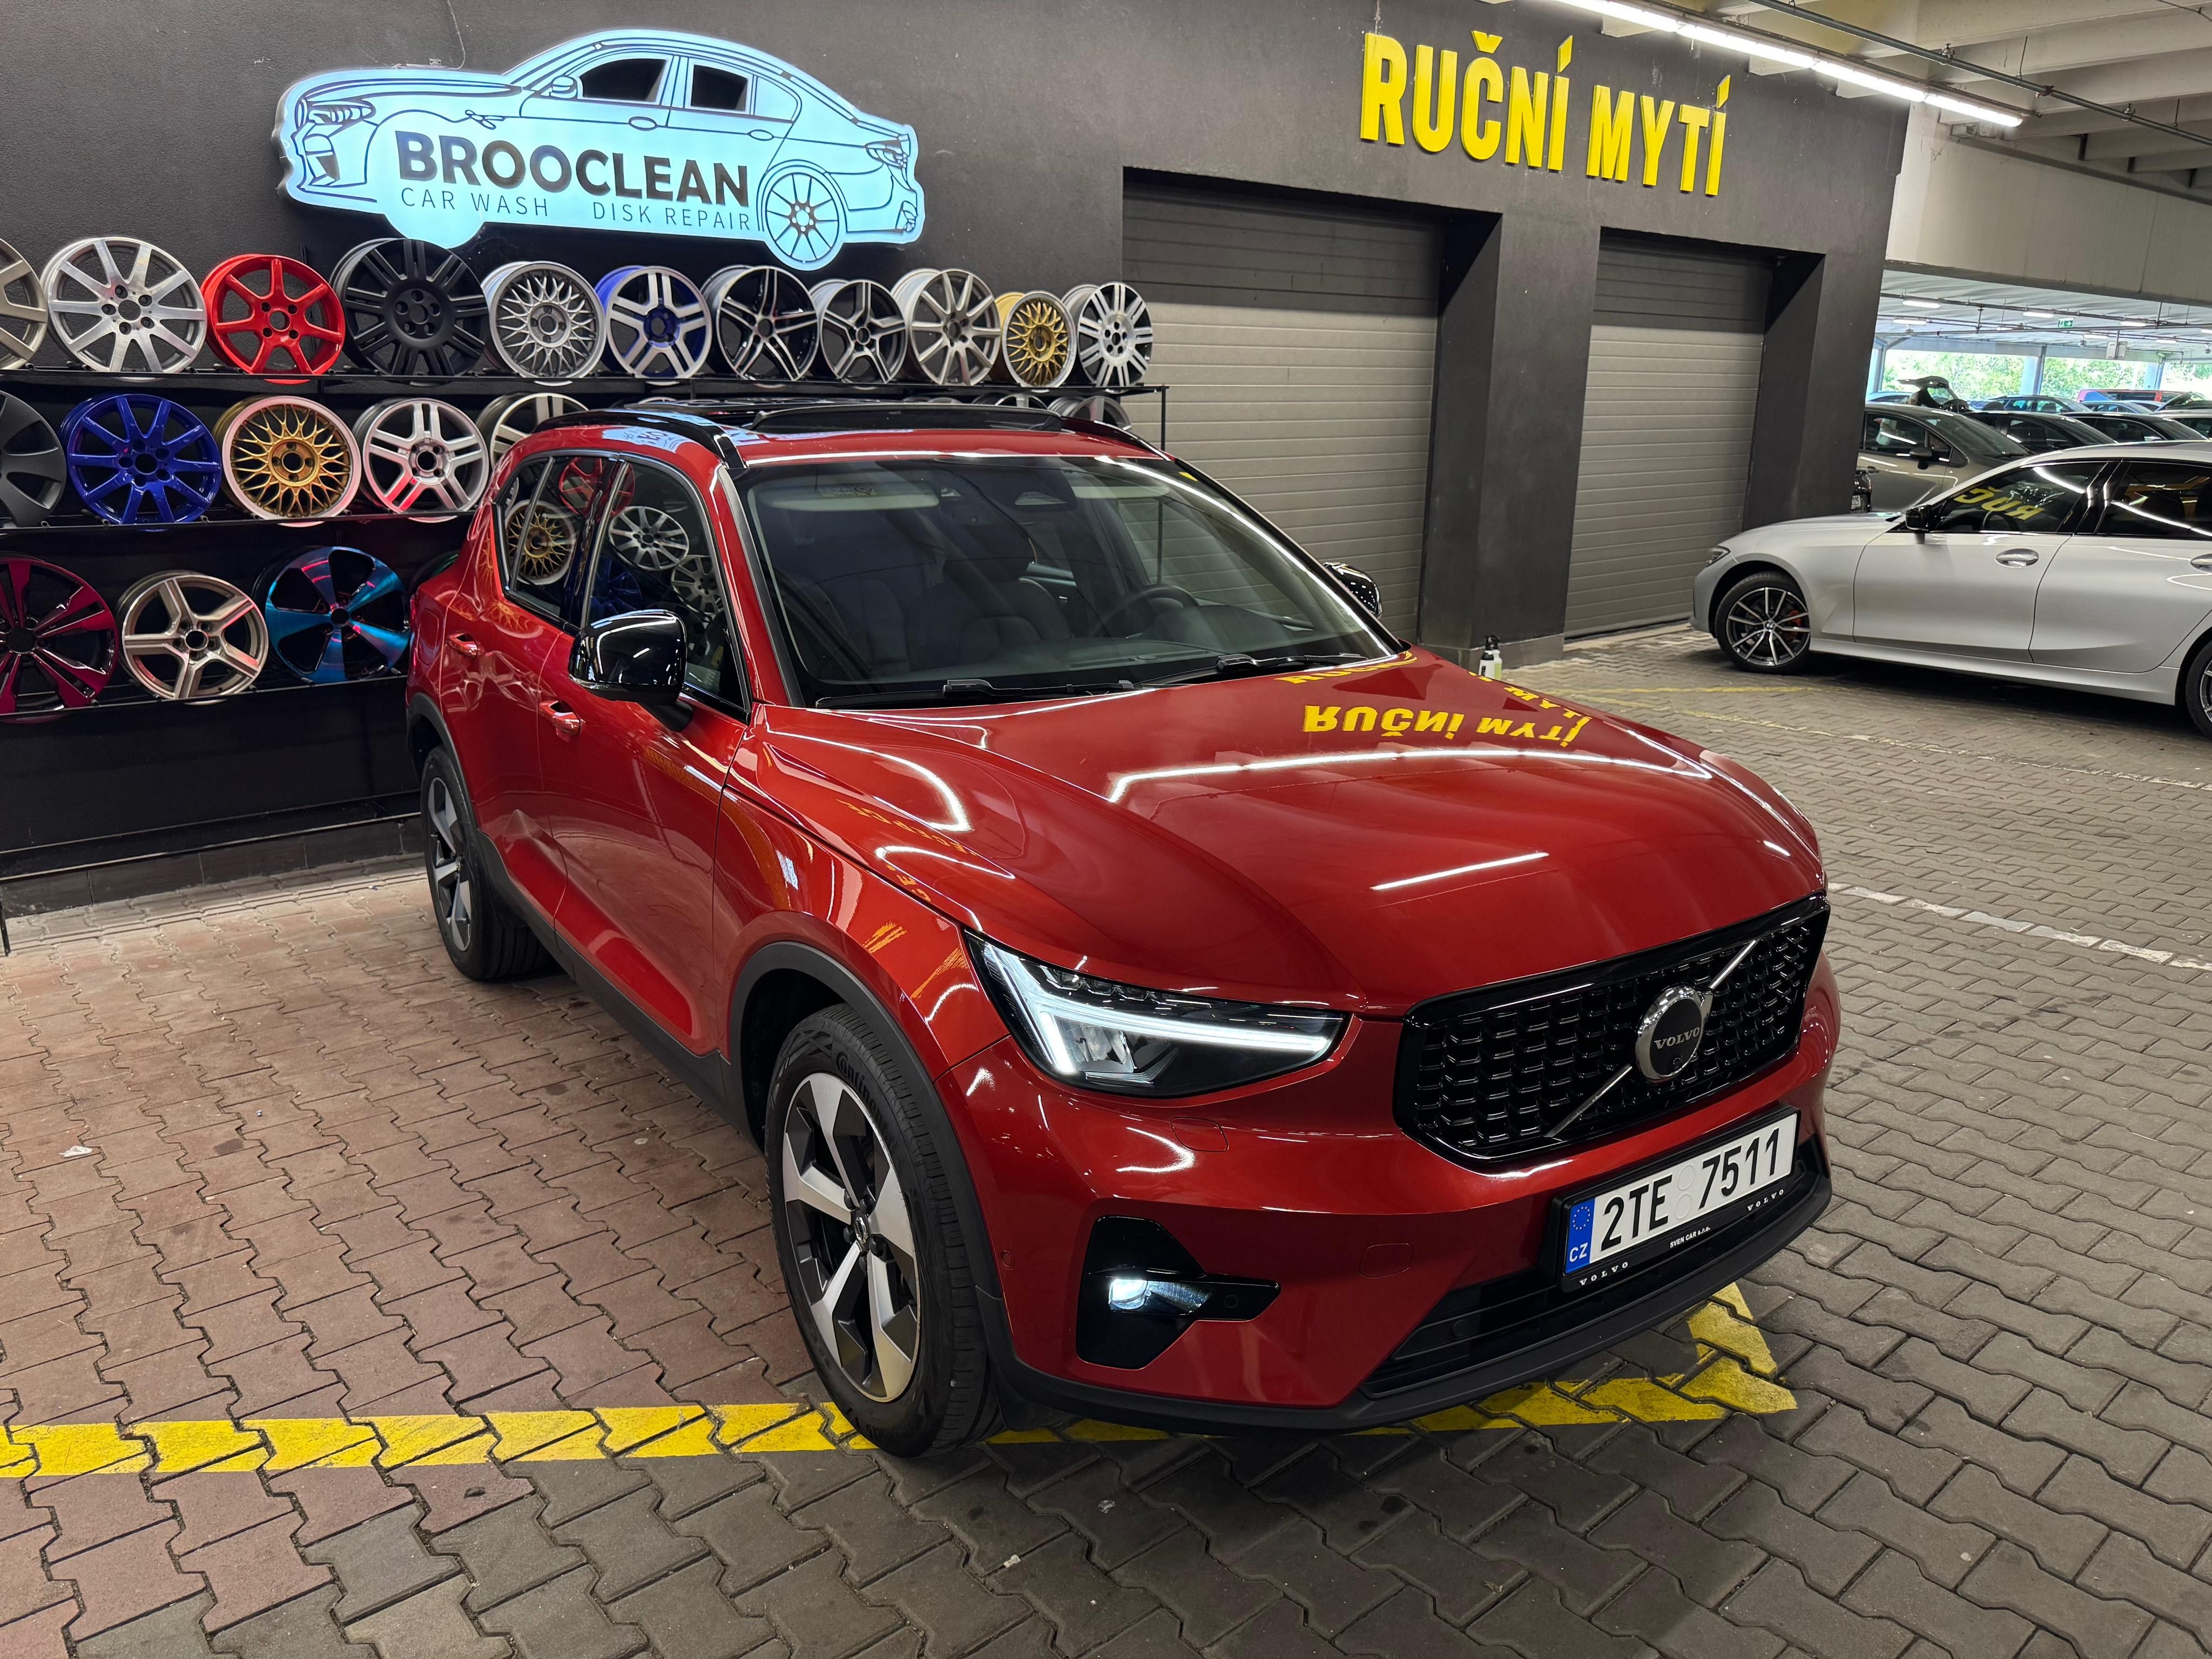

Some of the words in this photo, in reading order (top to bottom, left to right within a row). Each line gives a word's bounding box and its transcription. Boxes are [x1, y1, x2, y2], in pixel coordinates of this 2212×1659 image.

[1360, 31, 1573, 172] RUČNÍ
[1586, 76, 1731, 197] MYTÍ
[394, 130, 749, 208] BROOCLEAN
[401, 187, 455, 210] CAR
[470, 193, 548, 217] WASH
[592, 201, 652, 223] DISK
[665, 207, 750, 231] REPAIR
[1654, 1027, 1701, 1049] VOLVO
[1569, 1242, 1588, 1263] CZ
[1600, 1174, 1673, 1252] 2TE
[1698, 1127, 1780, 1210] 7511
[1746, 1189, 1784, 1211] VOLVO
[1670, 1236, 1684, 1248] SVEN
[1685, 1231, 1697, 1240] CAR
[1697, 1226, 1711, 1236] s.r.o.
[1579, 1261, 1629, 1286] VOLVO
